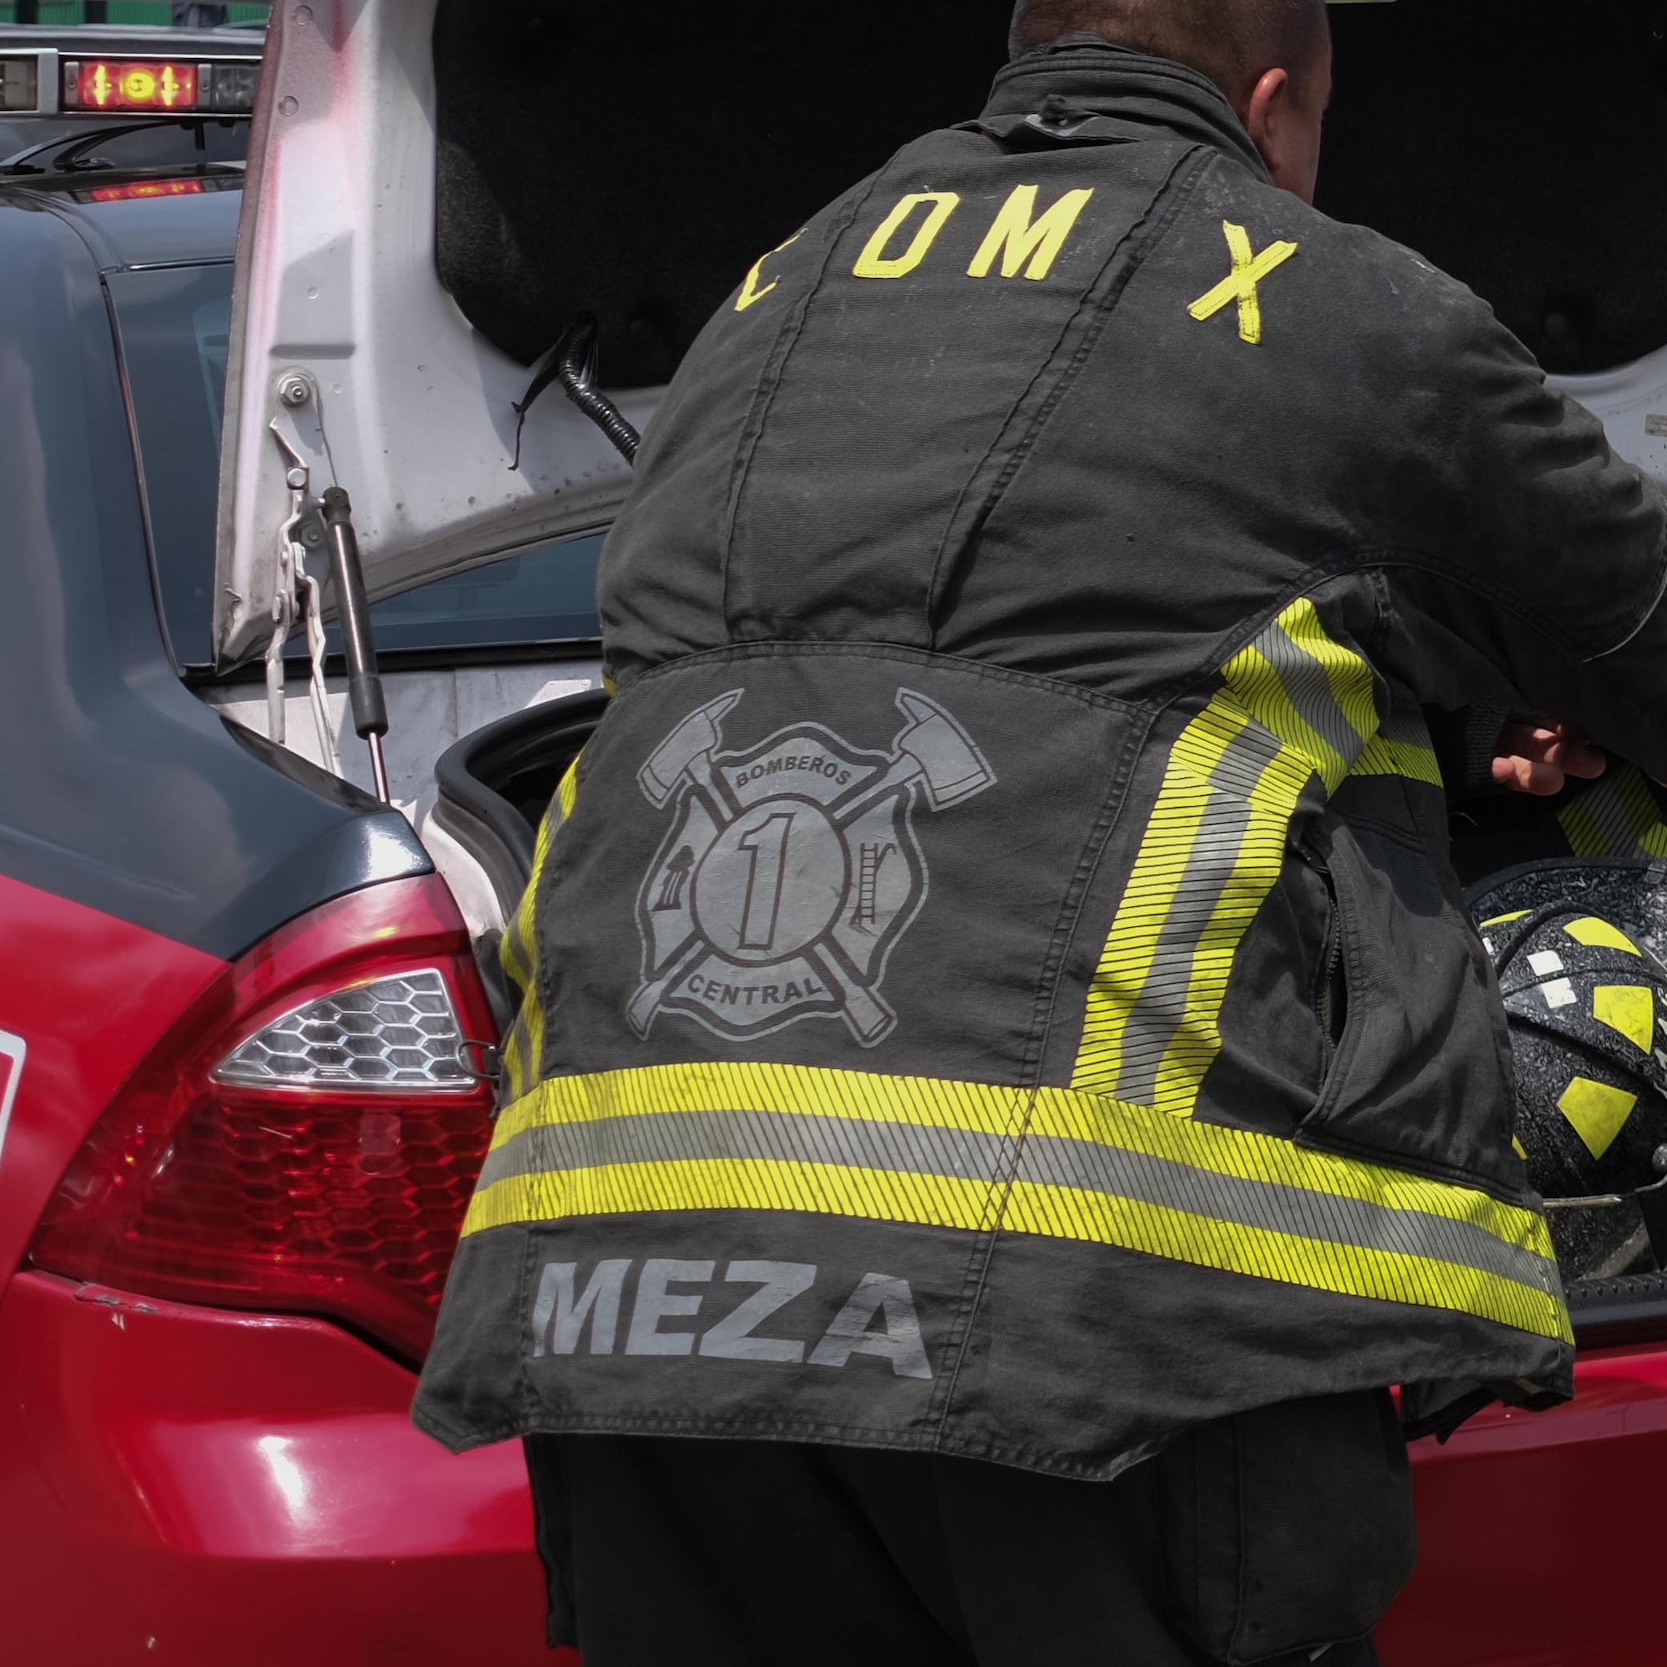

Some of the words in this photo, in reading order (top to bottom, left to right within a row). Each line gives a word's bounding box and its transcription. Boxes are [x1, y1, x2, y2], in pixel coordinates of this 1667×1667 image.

[734, 754, 853, 789] BOMBEROS
[736, 812, 796, 950] 1
[687, 977, 824, 1005] CENTRAL
[532, 1258, 933, 1380] MEZA
